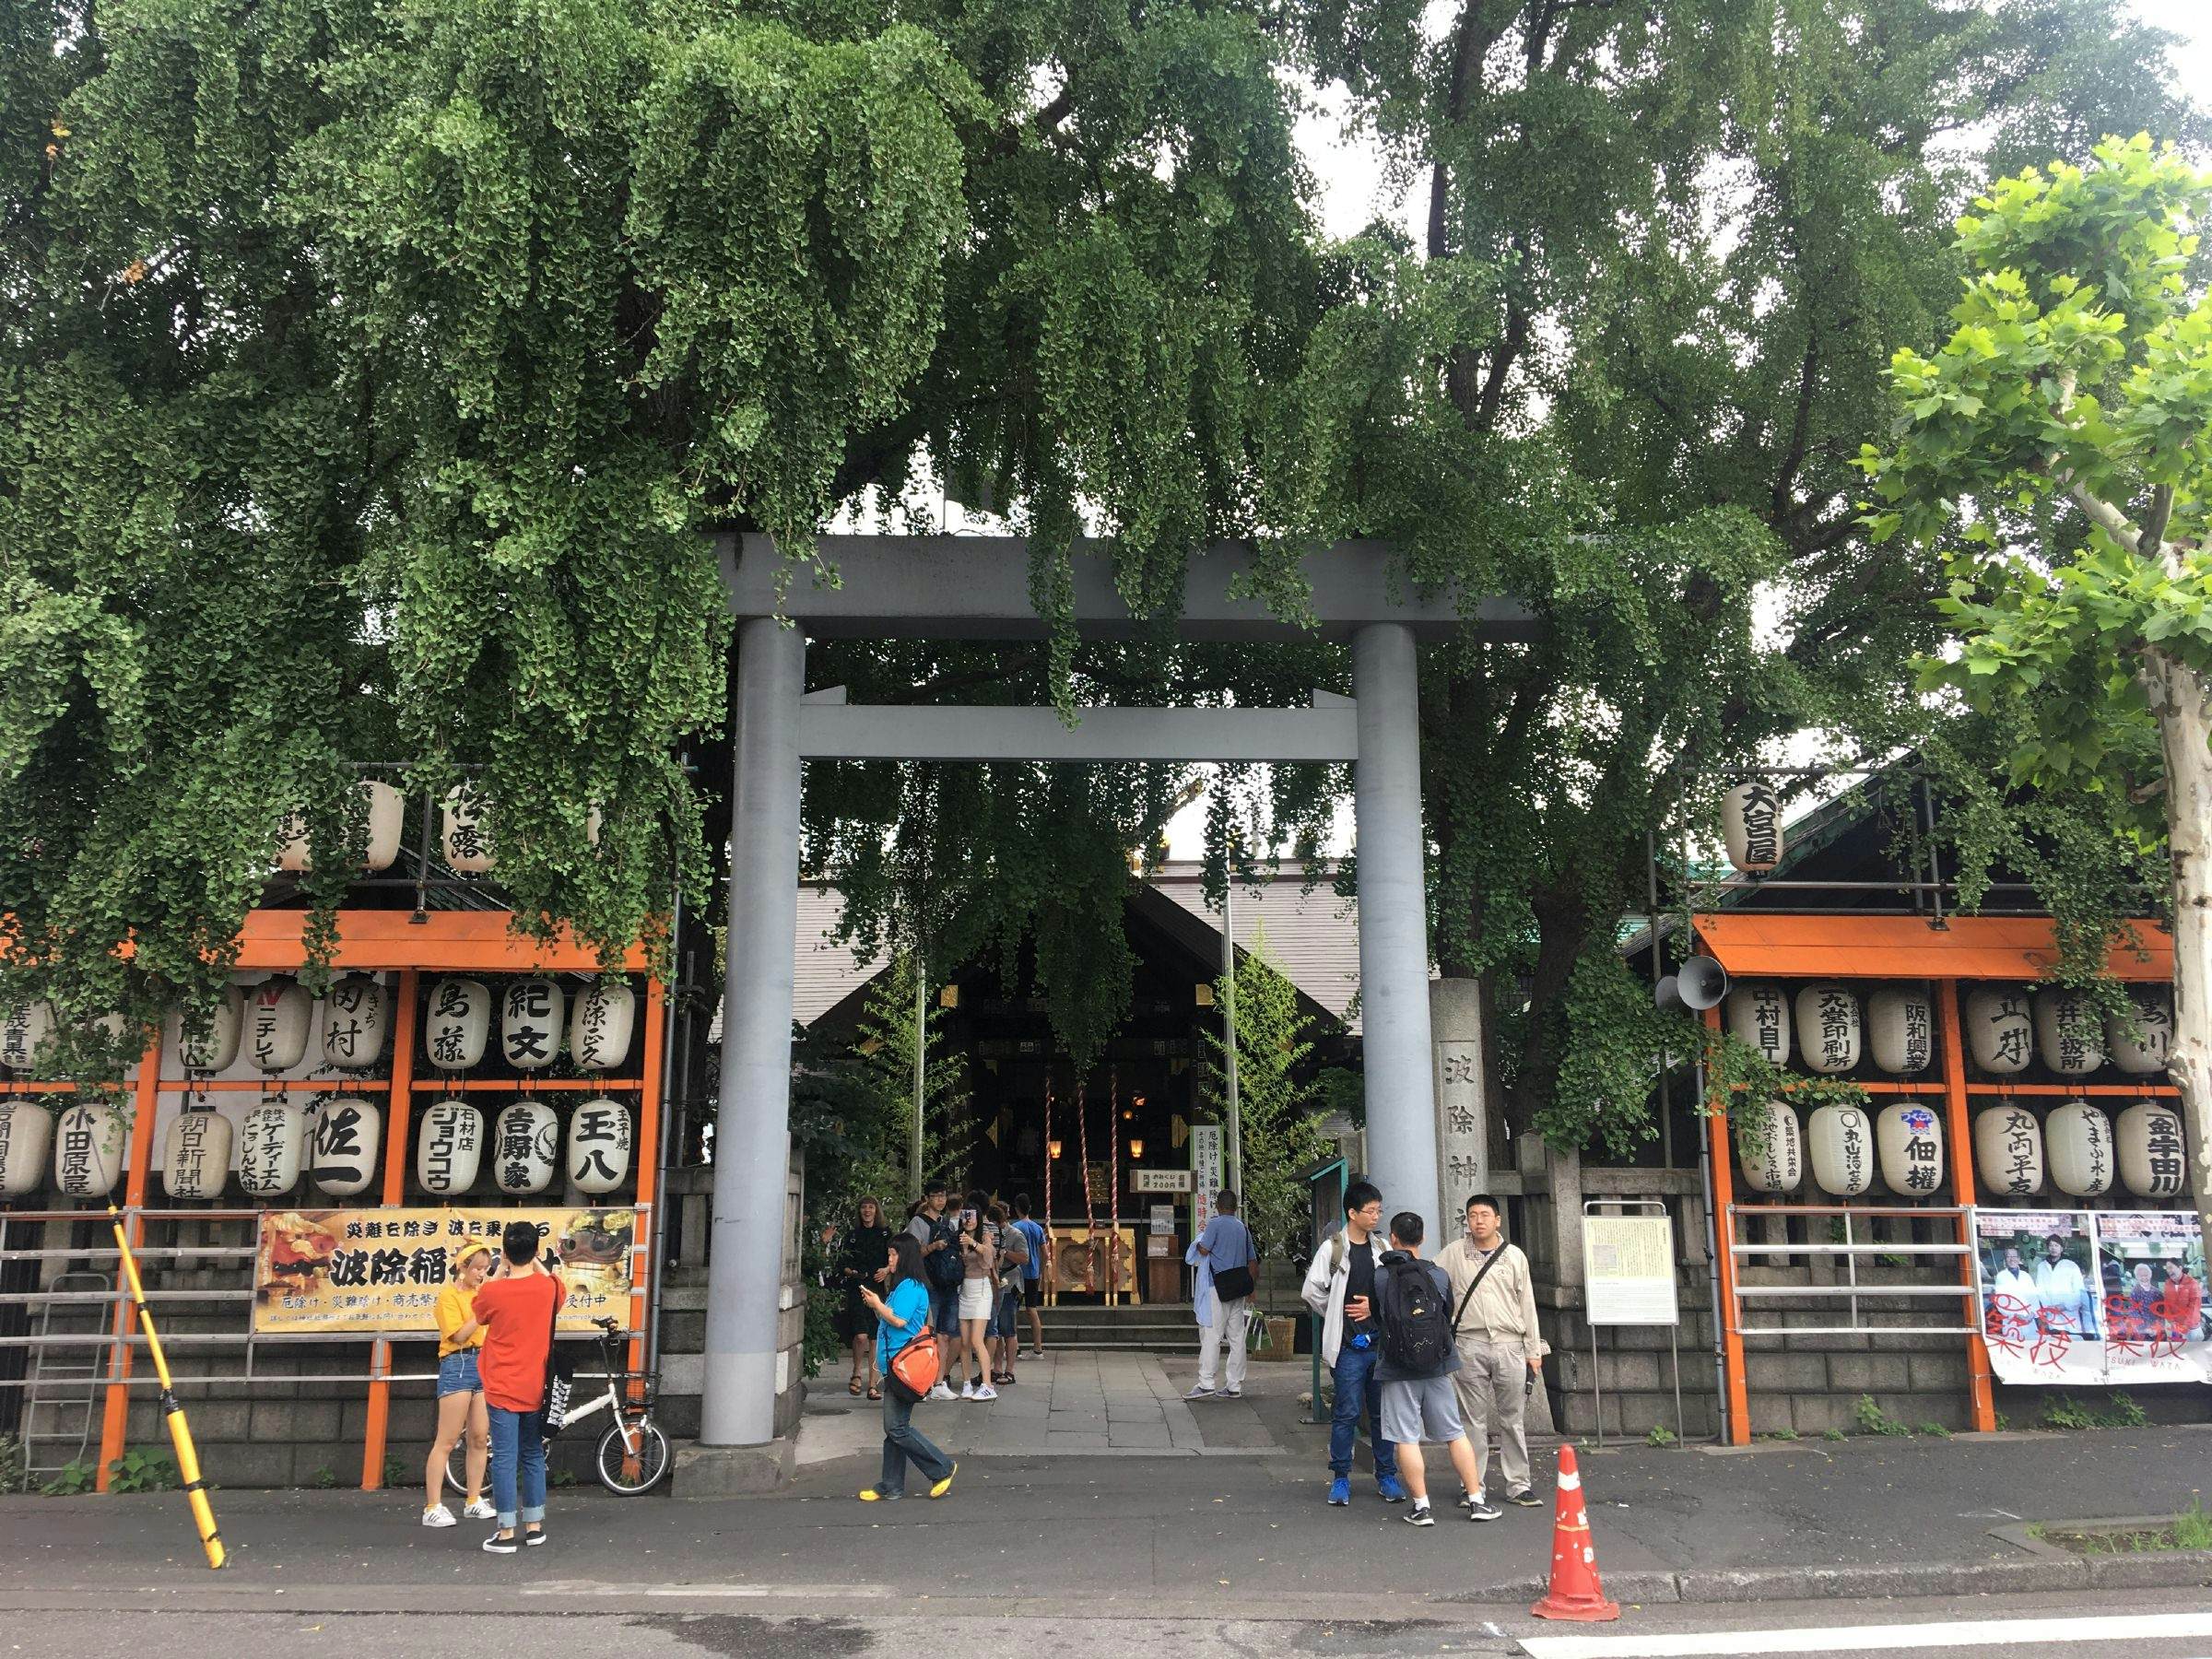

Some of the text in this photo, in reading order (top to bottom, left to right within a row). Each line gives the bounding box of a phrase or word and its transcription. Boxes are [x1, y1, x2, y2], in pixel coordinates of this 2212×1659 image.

[255, 1007, 277, 1065] ニチレイ
[326, 982, 365, 1058] 田村
[507, 984, 551, 1060] 紀文
[1902, 1004, 1929, 1070] 阪和興業
[61, 1107, 97, 1195] 小田原屋
[173, 1113, 208, 1199] 朝日新聞社
[315, 1106, 363, 1183] 佐一
[427, 1107, 460, 1191] ジョウコウ
[458, 1108, 475, 1152] 石材店
[502, 1108, 536, 1188] 吉野家
[1208, 1131, 1218, 1218] 厄除け・災難除け・
[565, 1293, 607, 1309] 受付中
